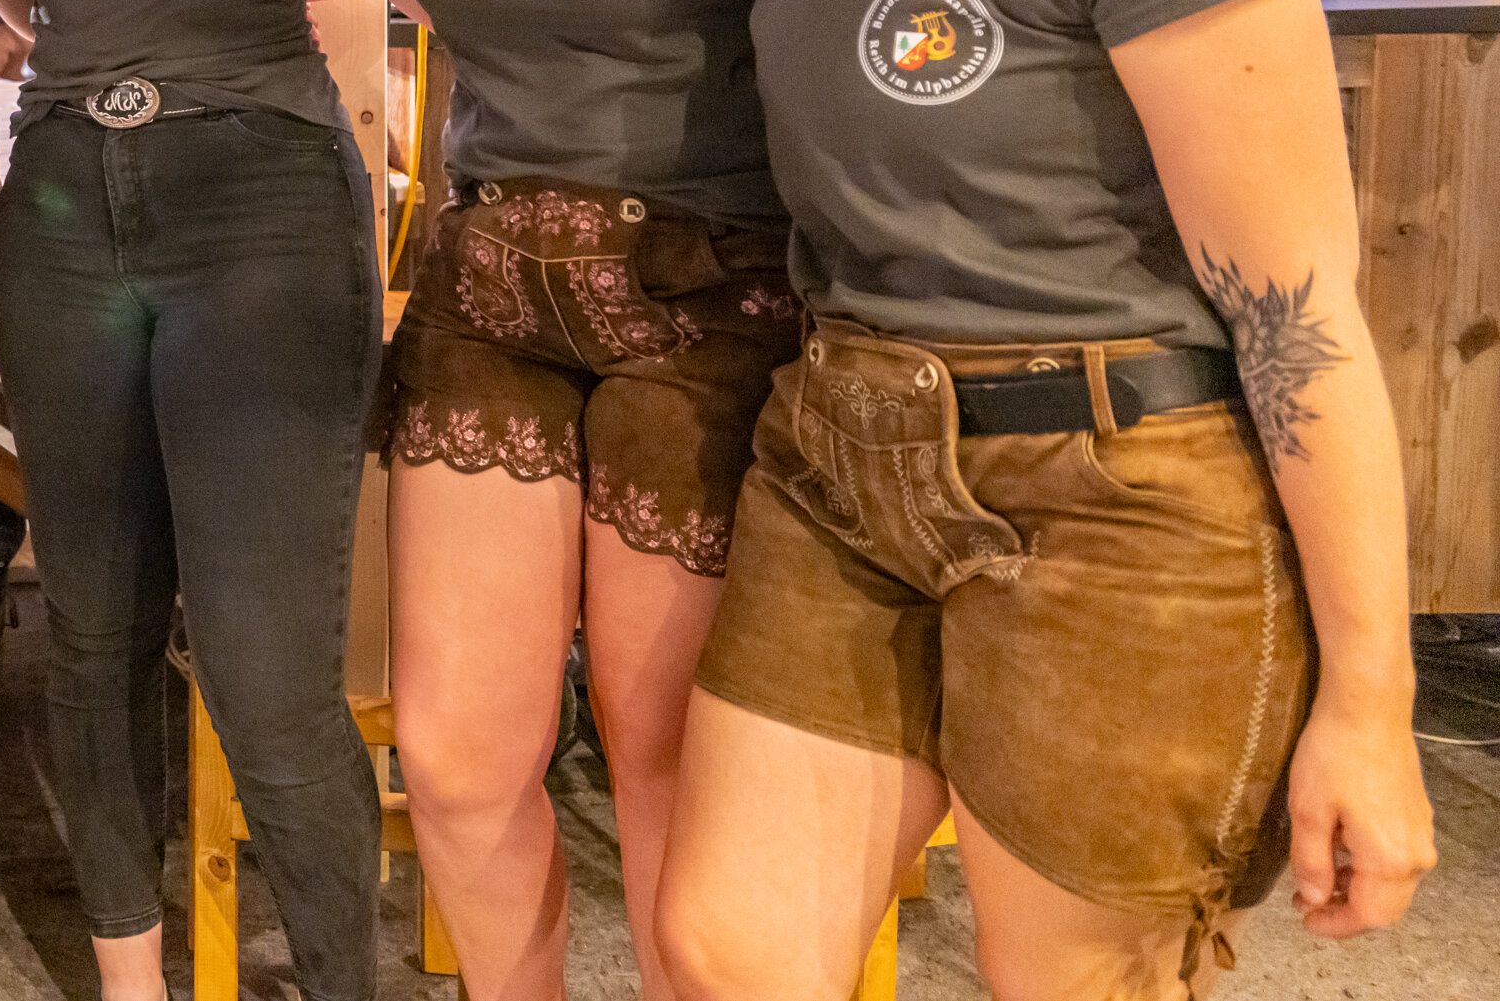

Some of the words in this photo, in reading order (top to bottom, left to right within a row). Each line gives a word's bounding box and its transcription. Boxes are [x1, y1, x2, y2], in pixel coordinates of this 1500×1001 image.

[869, 39, 889, 76] Reith
[888, 72, 908, 90] im
[914, 45, 987, 95] Alpbachtal
